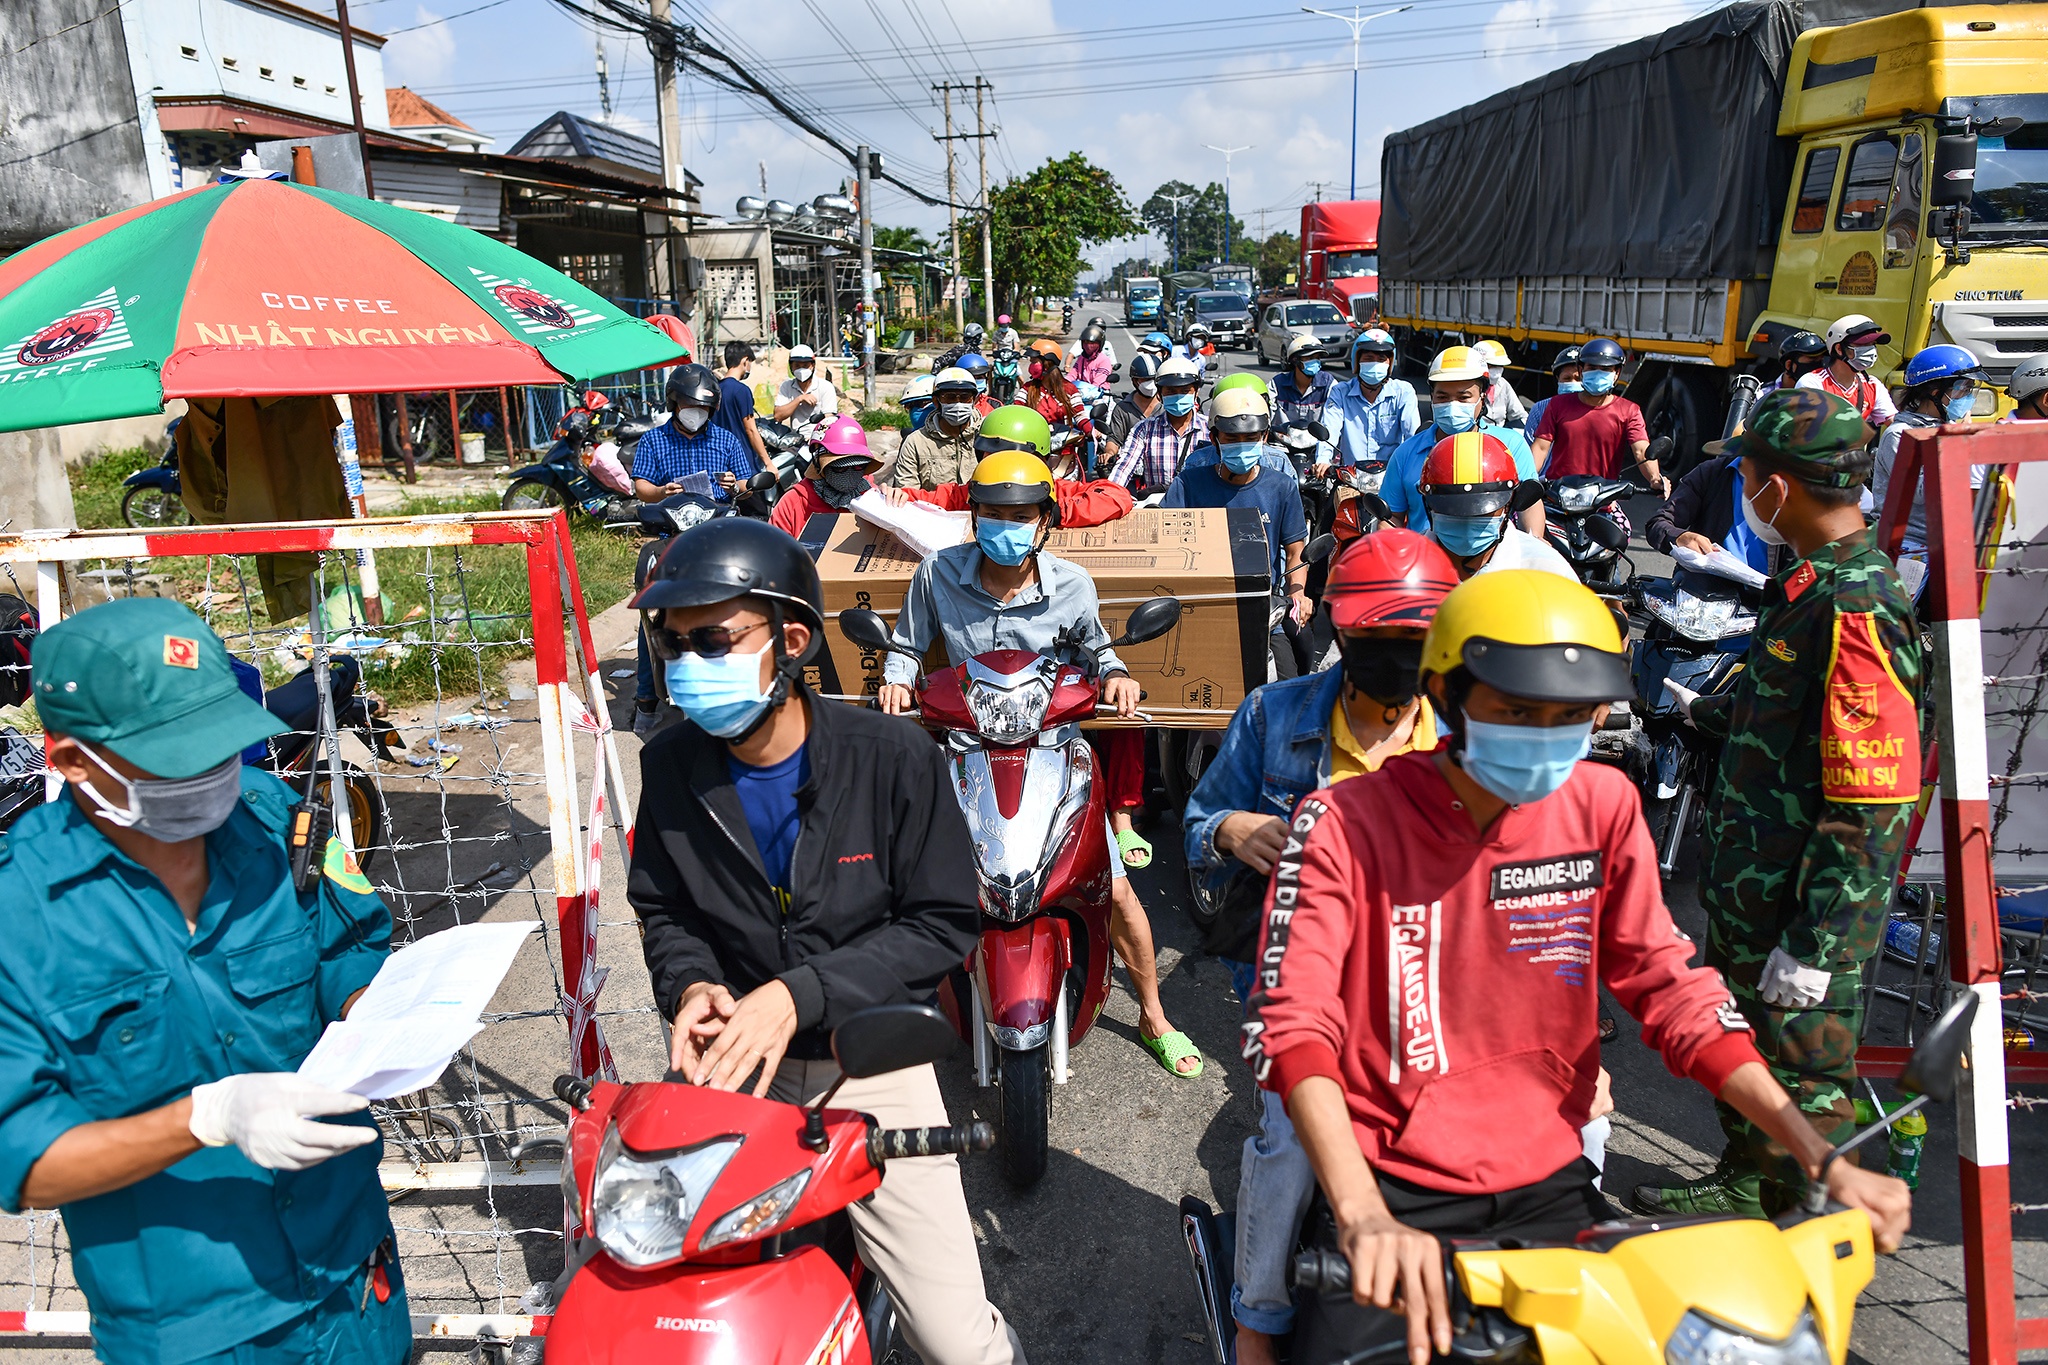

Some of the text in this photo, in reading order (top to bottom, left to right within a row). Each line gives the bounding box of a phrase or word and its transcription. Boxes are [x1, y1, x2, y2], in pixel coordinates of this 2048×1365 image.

[261, 292, 398, 314] COFFEE
[1955, 289, 2024, 301] SINOTRUK
[1190, 689, 1198, 702] 14L
[1203, 684, 1212, 708] 200W
[1821, 733, 1905, 759] IỂM SOÁT
[1822, 763, 1900, 790] QUÂN SỰ
[1500, 859, 1594, 890] EGANDE-UP
[1493, 887, 1597, 910] EGANDE-UP
[1392, 903, 1436, 1073] EGANDE-UP
[654, 1316, 733, 1335] HONDA
